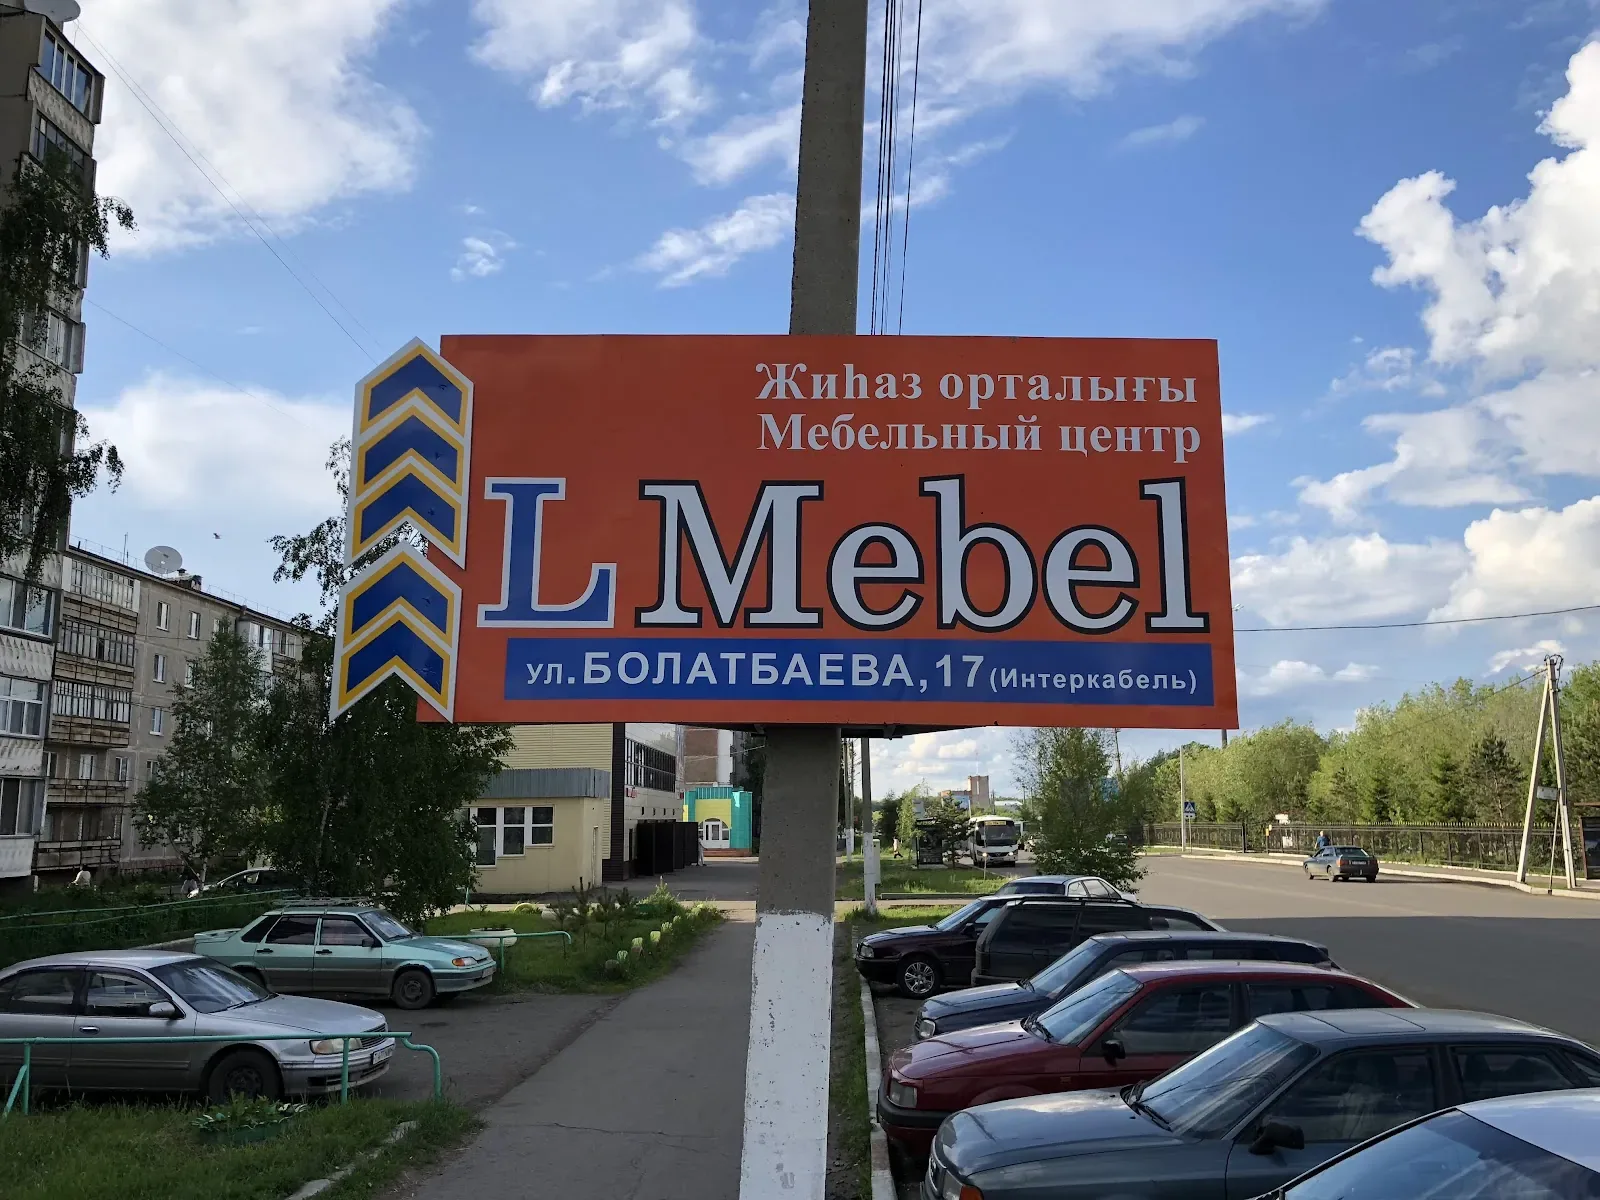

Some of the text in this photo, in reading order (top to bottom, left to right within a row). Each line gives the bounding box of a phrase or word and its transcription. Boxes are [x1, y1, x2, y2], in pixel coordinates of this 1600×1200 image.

[939, 373, 1197, 410] орталығы
[756, 413, 1201, 463] Мебельный центр
[477, 473, 1210, 635] L Mebel
[989, 667, 1197, 694] (Интеркабель)
